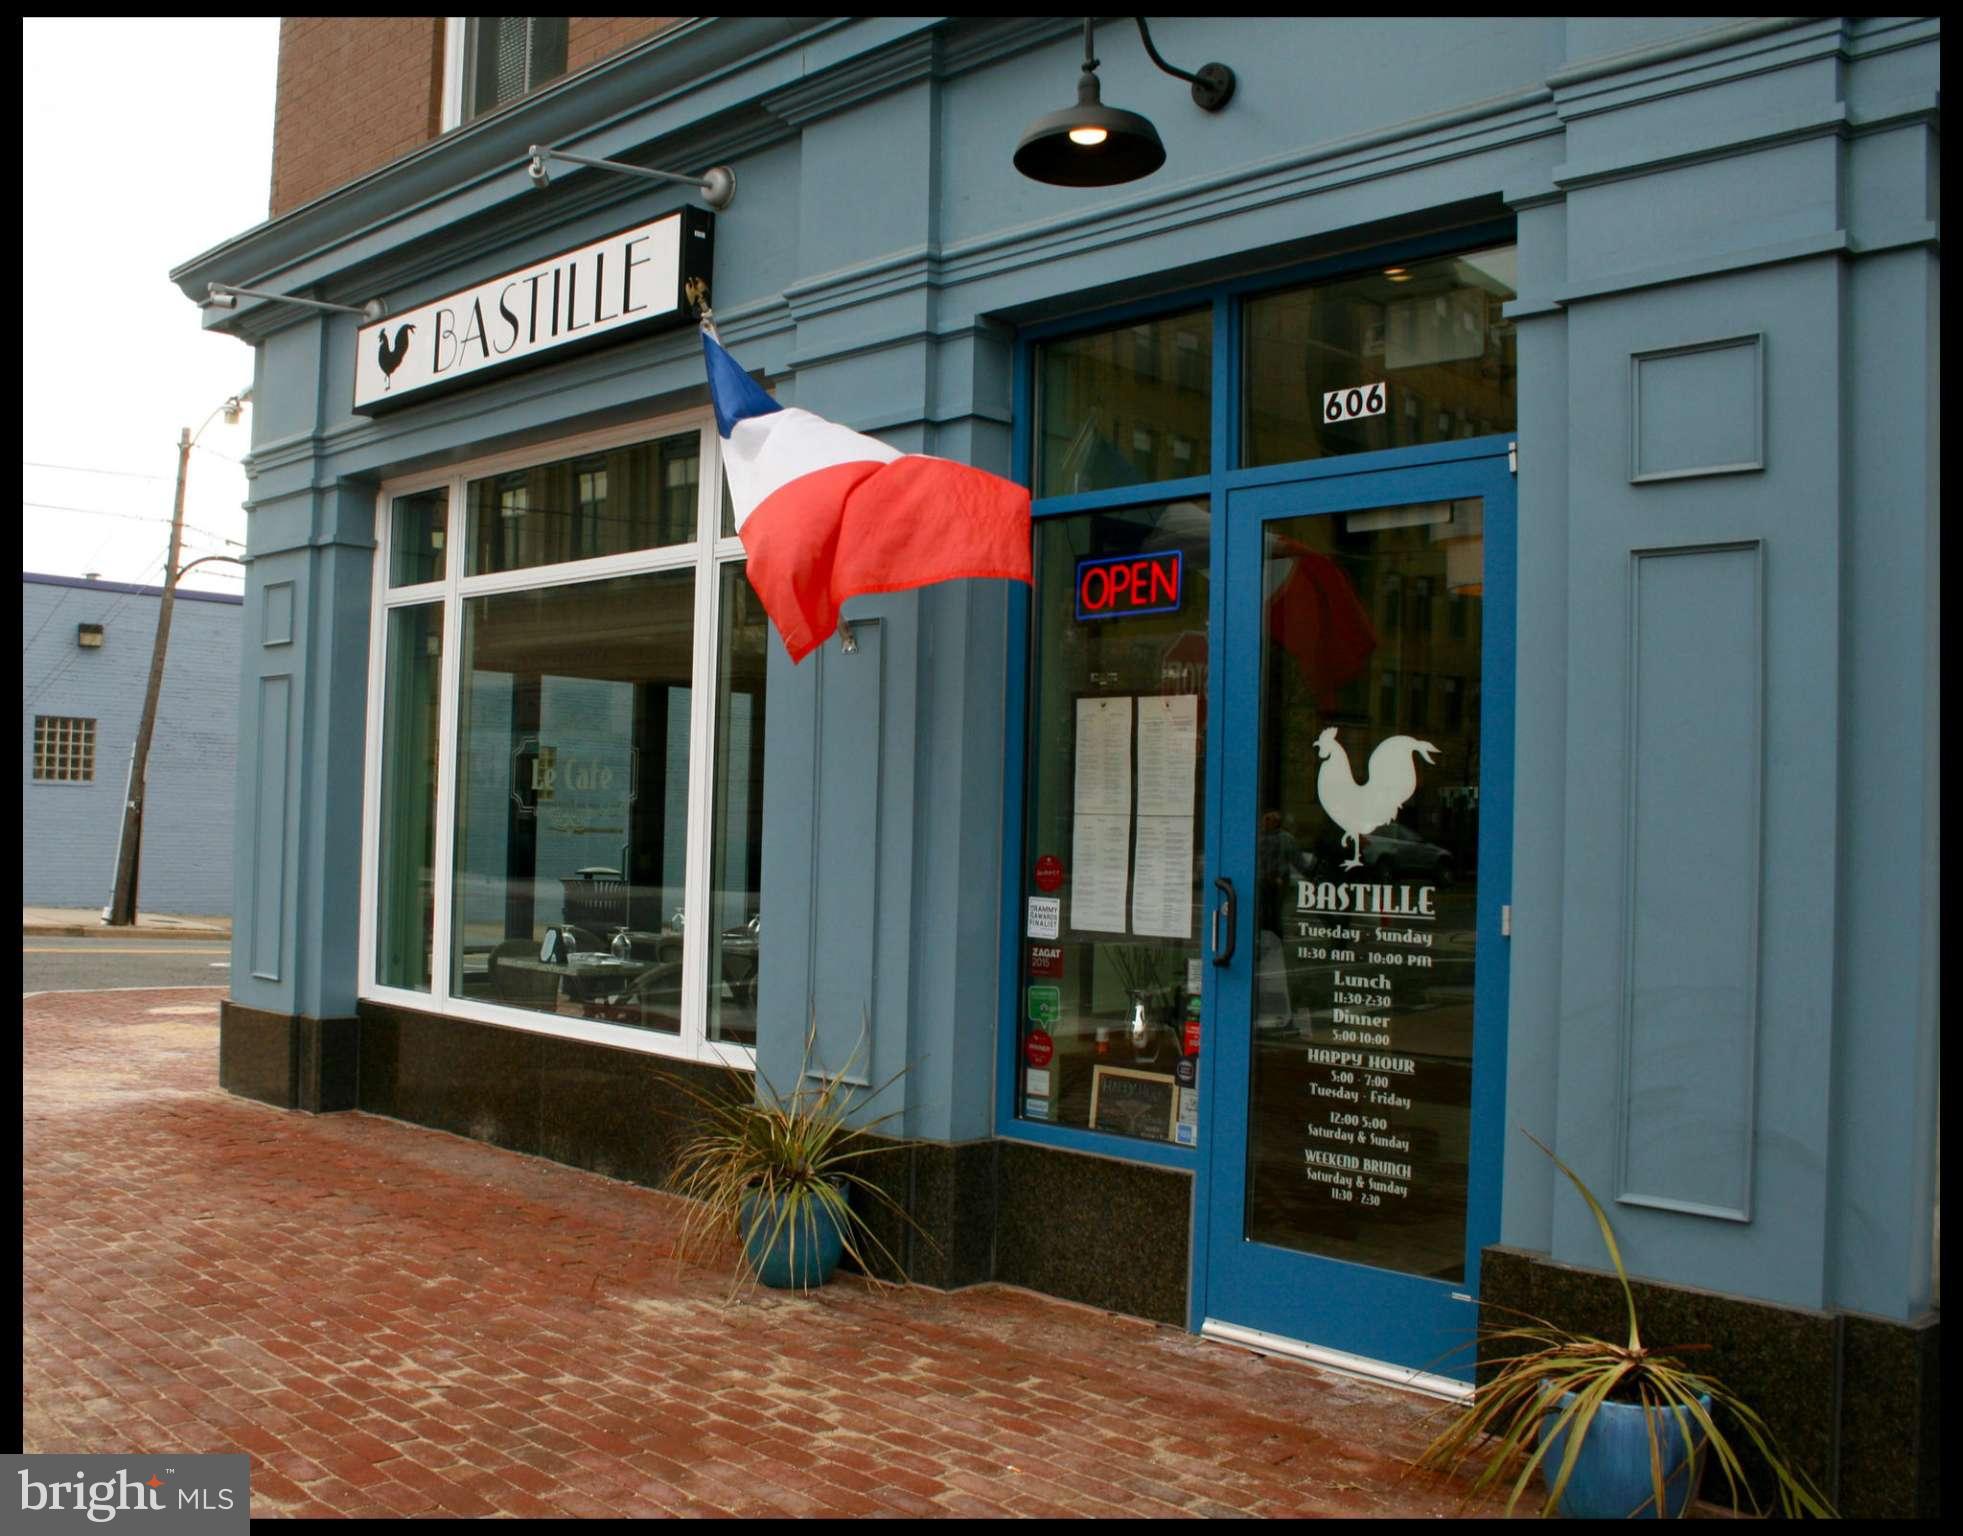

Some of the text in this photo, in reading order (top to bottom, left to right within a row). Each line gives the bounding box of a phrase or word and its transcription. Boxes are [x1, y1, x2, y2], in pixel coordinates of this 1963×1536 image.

[433, 236, 650, 374] BASTILLE
[1325, 384, 1383, 421] 606
[1081, 557, 1179, 610] OPEN
[1297, 880, 1436, 916] BASTILLE
[1297, 921, 1360, 943] Tuesday
[1375, 926, 1433, 947] Sunday
[1032, 947, 1061, 958] ZAGAT
[1297, 946, 1326, 960] 11:30
[1331, 949, 1355, 962] AM
[1368, 951, 1403, 965] 10:00
[1407, 954, 1432, 967] PM
[1334, 970, 1391, 990] Lunch
[1333, 1008, 1390, 1028] Dinner
[1307, 1048, 1416, 1074] HAPPY HOUR
[1331, 1070, 1354, 1084] 5:00
[1364, 1073, 1389, 1088] 7:00
[1308, 1082, 1359, 1103] Tuesday
[1370, 1090, 1411, 1110] Friday
[1330, 1111, 1388, 1130] 12:00 5:00
[1308, 1123, 1410, 1153] Saturday & Sunday
[1304, 1149, 1412, 1179] WEEKEND BRUNCH
[1306, 1167, 1408, 1199] Saturday & Sunday
[1331, 1187, 1381, 1207] 11:30 2:30
